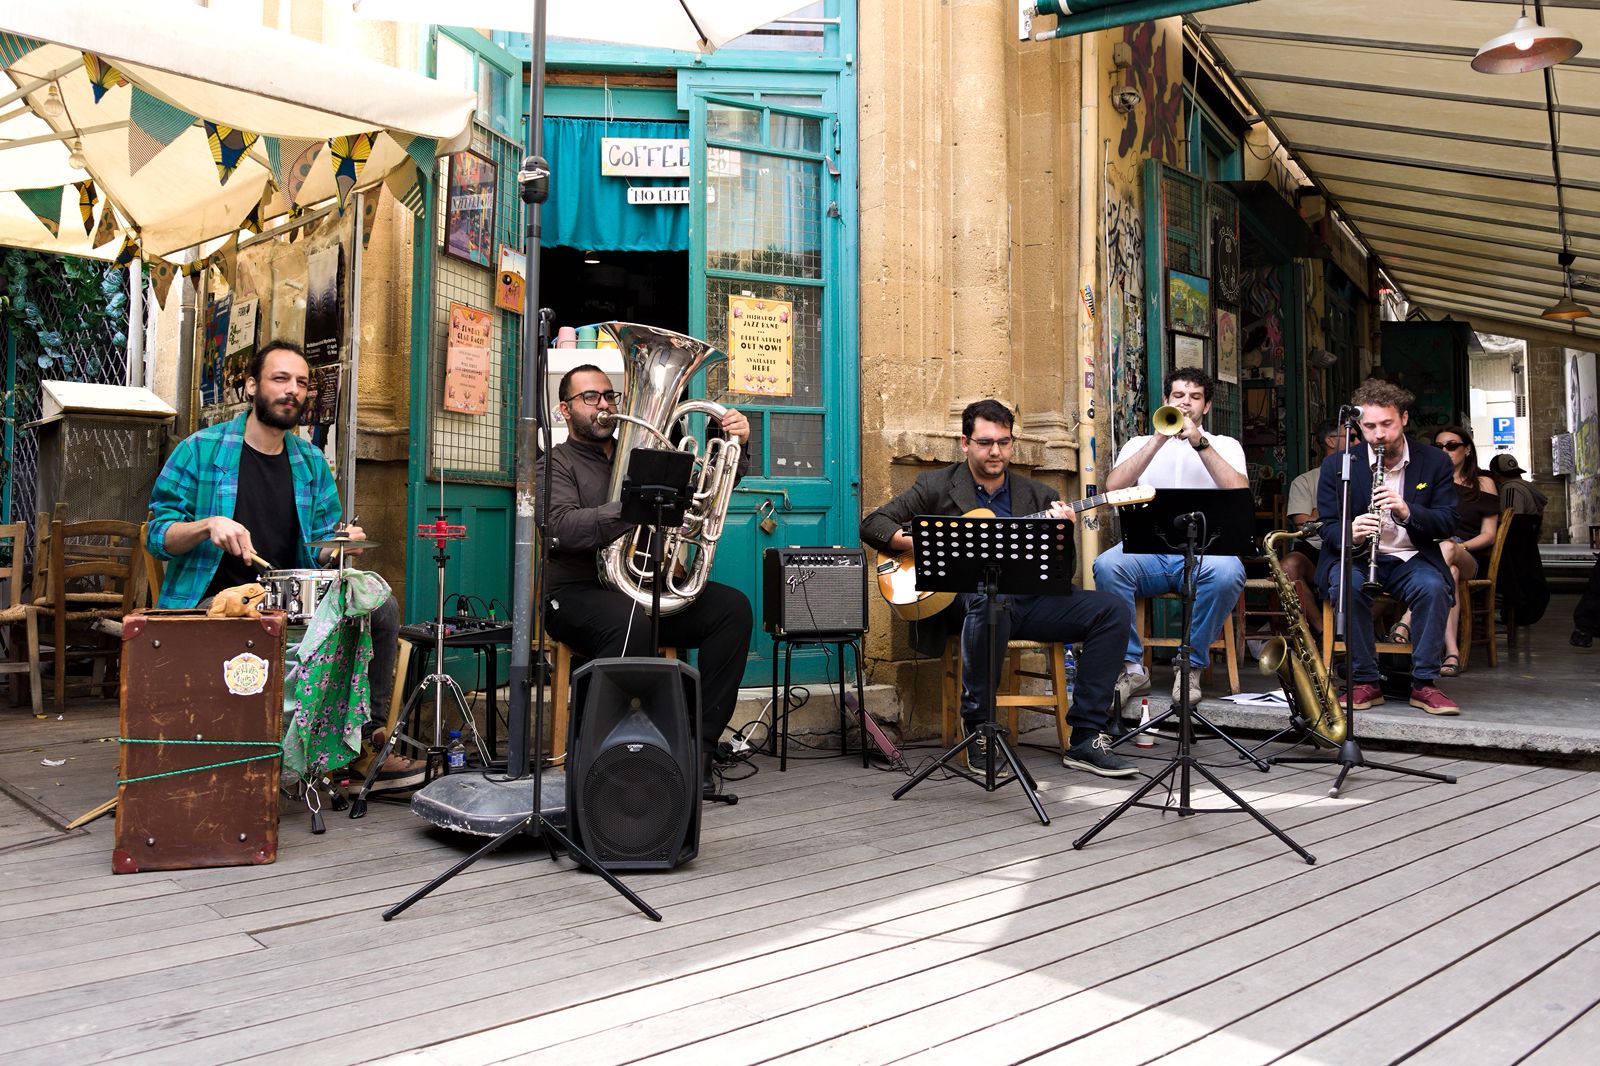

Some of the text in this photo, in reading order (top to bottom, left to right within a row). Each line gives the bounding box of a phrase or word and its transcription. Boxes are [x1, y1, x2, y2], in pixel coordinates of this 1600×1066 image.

[634, 190, 654, 202] NO
[740, 342, 782, 352] OUT NOW!
[1498, 419, 1510, 431] P
